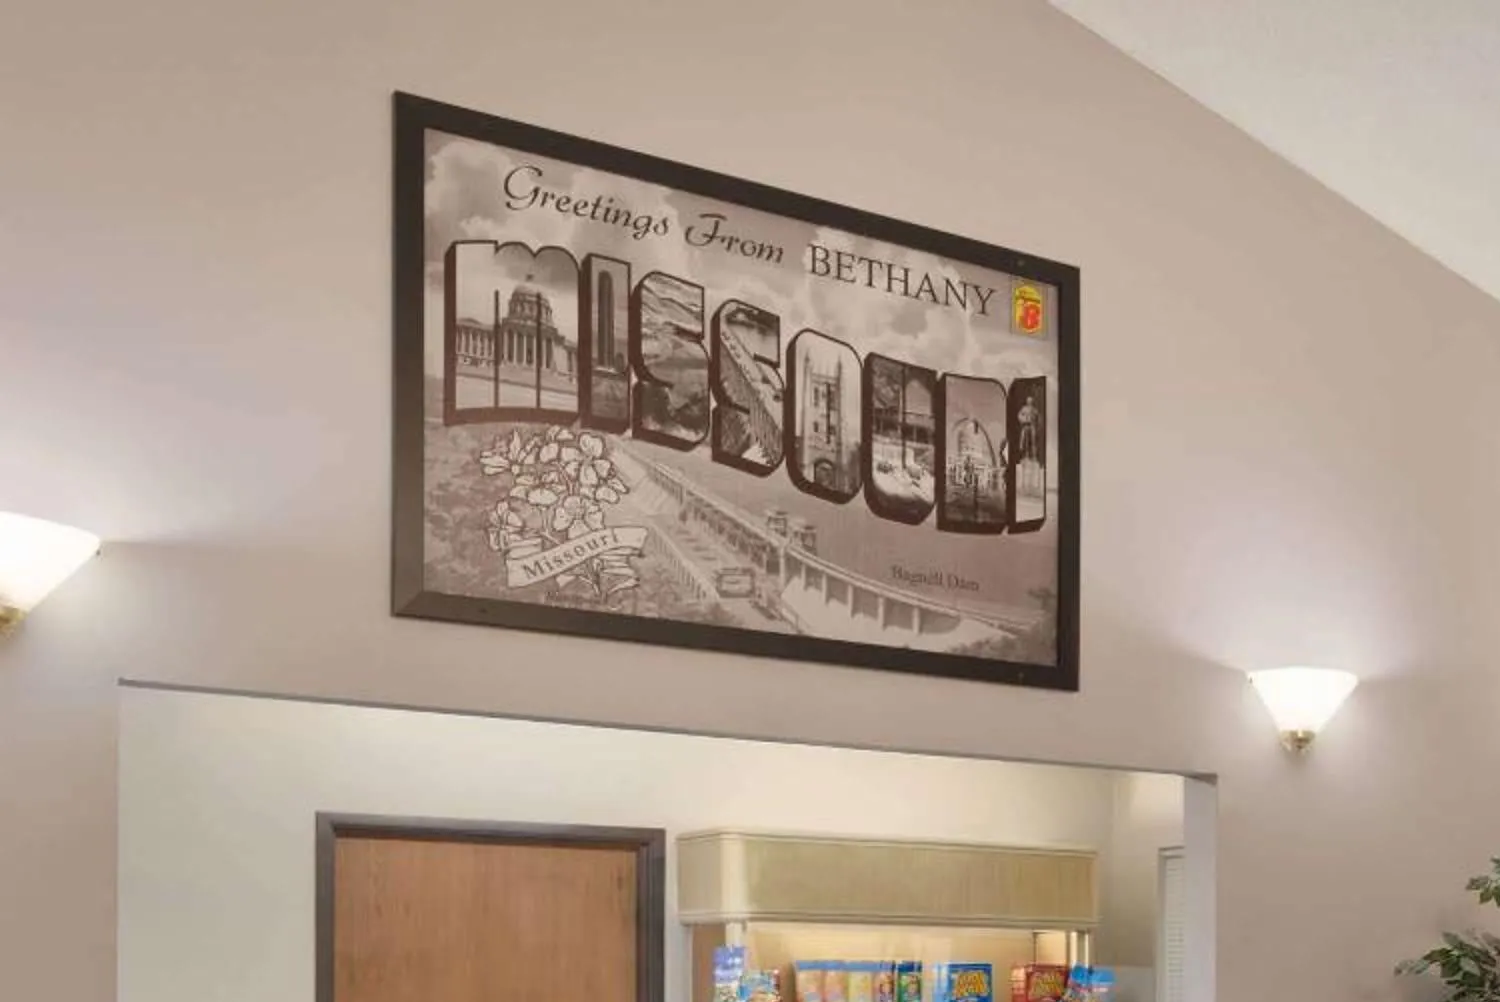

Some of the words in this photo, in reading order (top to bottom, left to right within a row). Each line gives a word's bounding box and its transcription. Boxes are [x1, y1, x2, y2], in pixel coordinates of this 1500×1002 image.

[504, 165, 669, 240] Greetings
[685, 213, 784, 265] From
[808, 243, 996, 315] BETHANY
[444, 239, 1048, 536] MISSOURI
[522, 528, 618, 580] Missouri
